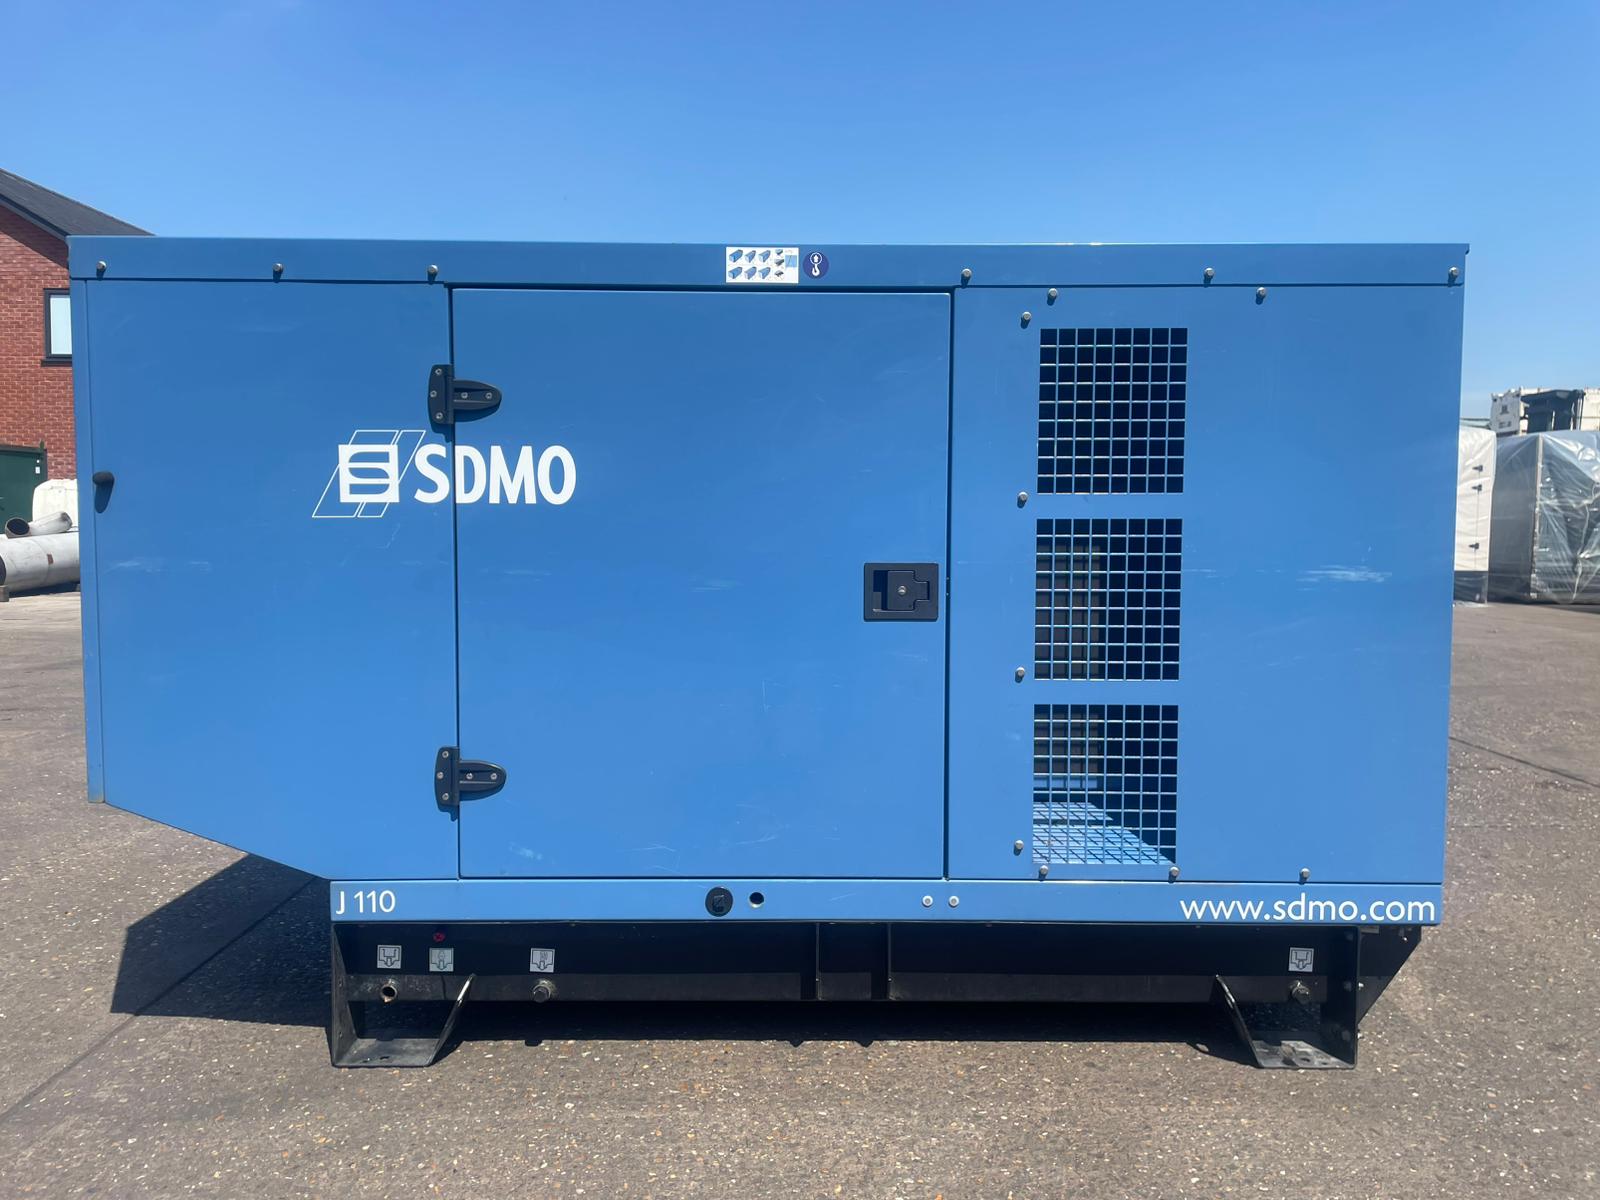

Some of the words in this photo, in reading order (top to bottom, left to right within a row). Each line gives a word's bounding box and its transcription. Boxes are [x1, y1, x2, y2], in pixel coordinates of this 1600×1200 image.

[413, 444, 577, 505] SDMO
[335, 891, 345, 915] J
[353, 890, 397, 913] 110
[1179, 892, 1436, 922] www.sdmo.com
